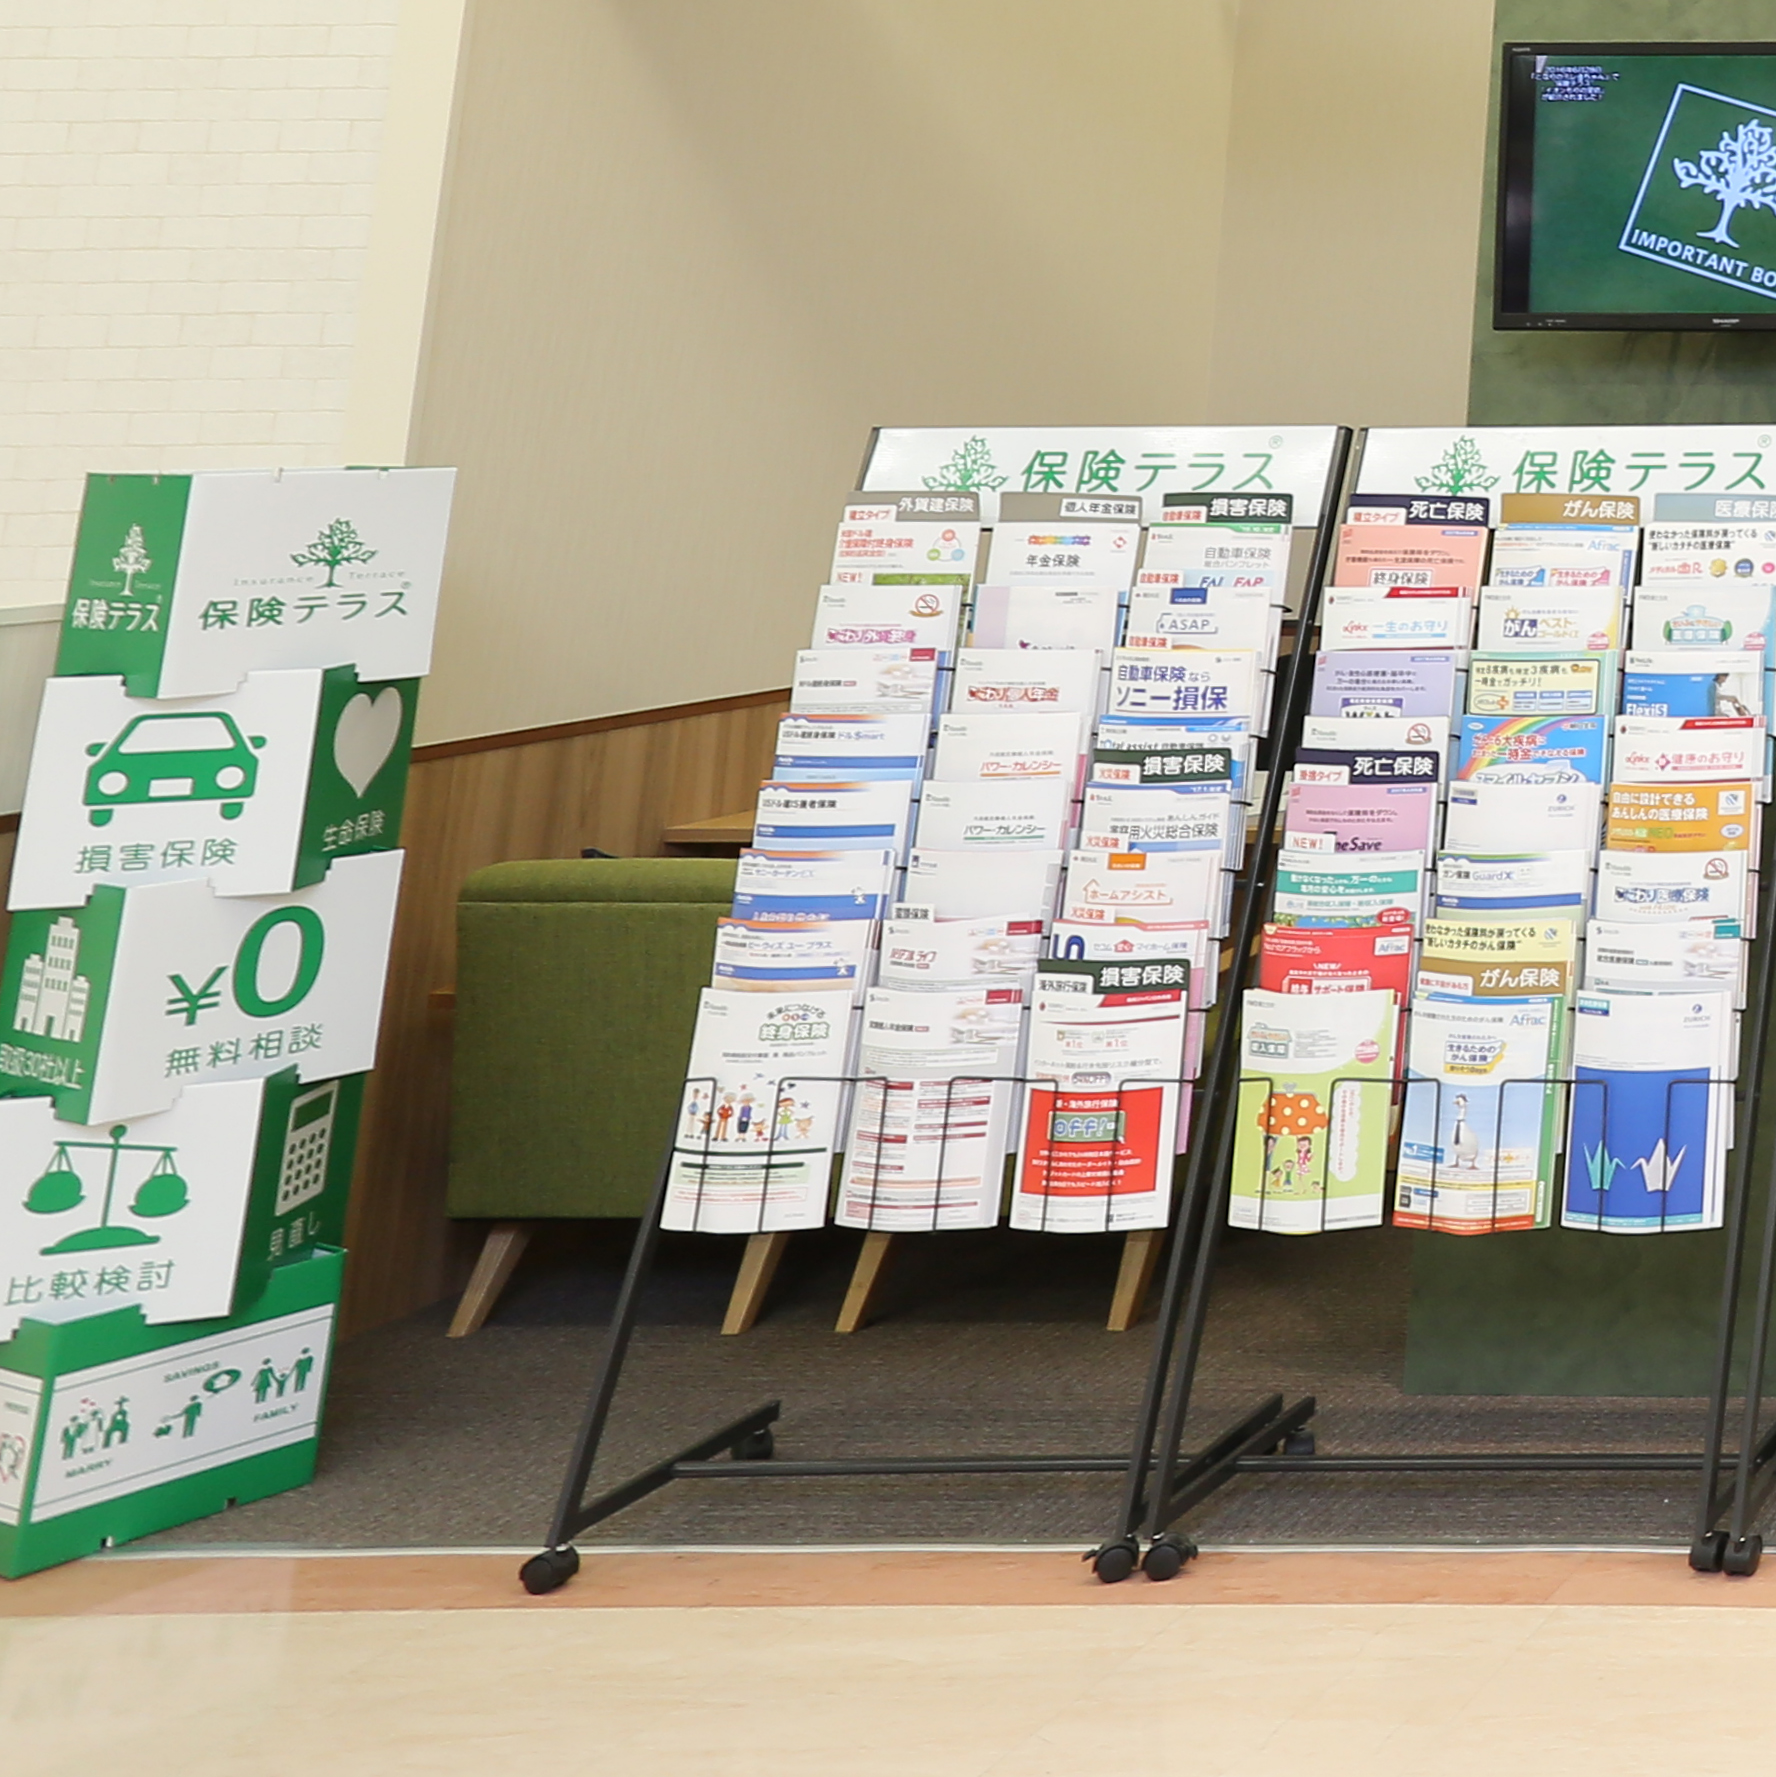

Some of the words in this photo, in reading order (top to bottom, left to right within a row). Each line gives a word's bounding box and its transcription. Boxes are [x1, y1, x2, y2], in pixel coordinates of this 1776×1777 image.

[1630, 228, 1749, 278] IMPORTANT
[1020, 449, 1276, 493] 保険テラス
[1512, 449, 1767, 493] 保険テラス
[1209, 497, 1288, 518] 損害保険
[1408, 500, 1486, 522] 死亡保険
[1562, 499, 1636, 520] がん保険
[1026, 554, 1081, 568] 年金保険
[1204, 547, 1272, 560] 自動車保険
[1372, 572, 1430, 586] 終身保険
[71, 597, 163, 633] 保険テラス
[198, 591, 410, 631] 保険テラス
[1168, 618, 1211, 631] ASAP
[1503, 619, 1538, 638] がん
[1116, 686, 1229, 712] ソニー損保
[1143, 754, 1226, 776] 損害保険
[1352, 756, 1435, 777] 死亡保険
[1611, 808, 1710, 821] あんしんの医療保険
[321, 809, 386, 854] 生命保険
[1292, 837, 1324, 850] NEW!
[75, 838, 239, 875] 損害保険
[1090, 889, 1167, 901] ホームアシスト
[1100, 965, 1185, 987] 損害保険
[1479, 968, 1561, 988] がん保険
[758, 1022, 830, 1041] 終身保険
[163, 1023, 325, 1079] 無料相談
[1446, 1042, 1496, 1053] 生きるための
[4, 1259, 176, 1307] 比較検討
[163, 1360, 221, 1383] SAVINGS
[253, 1403, 300, 1423] FAMILY
